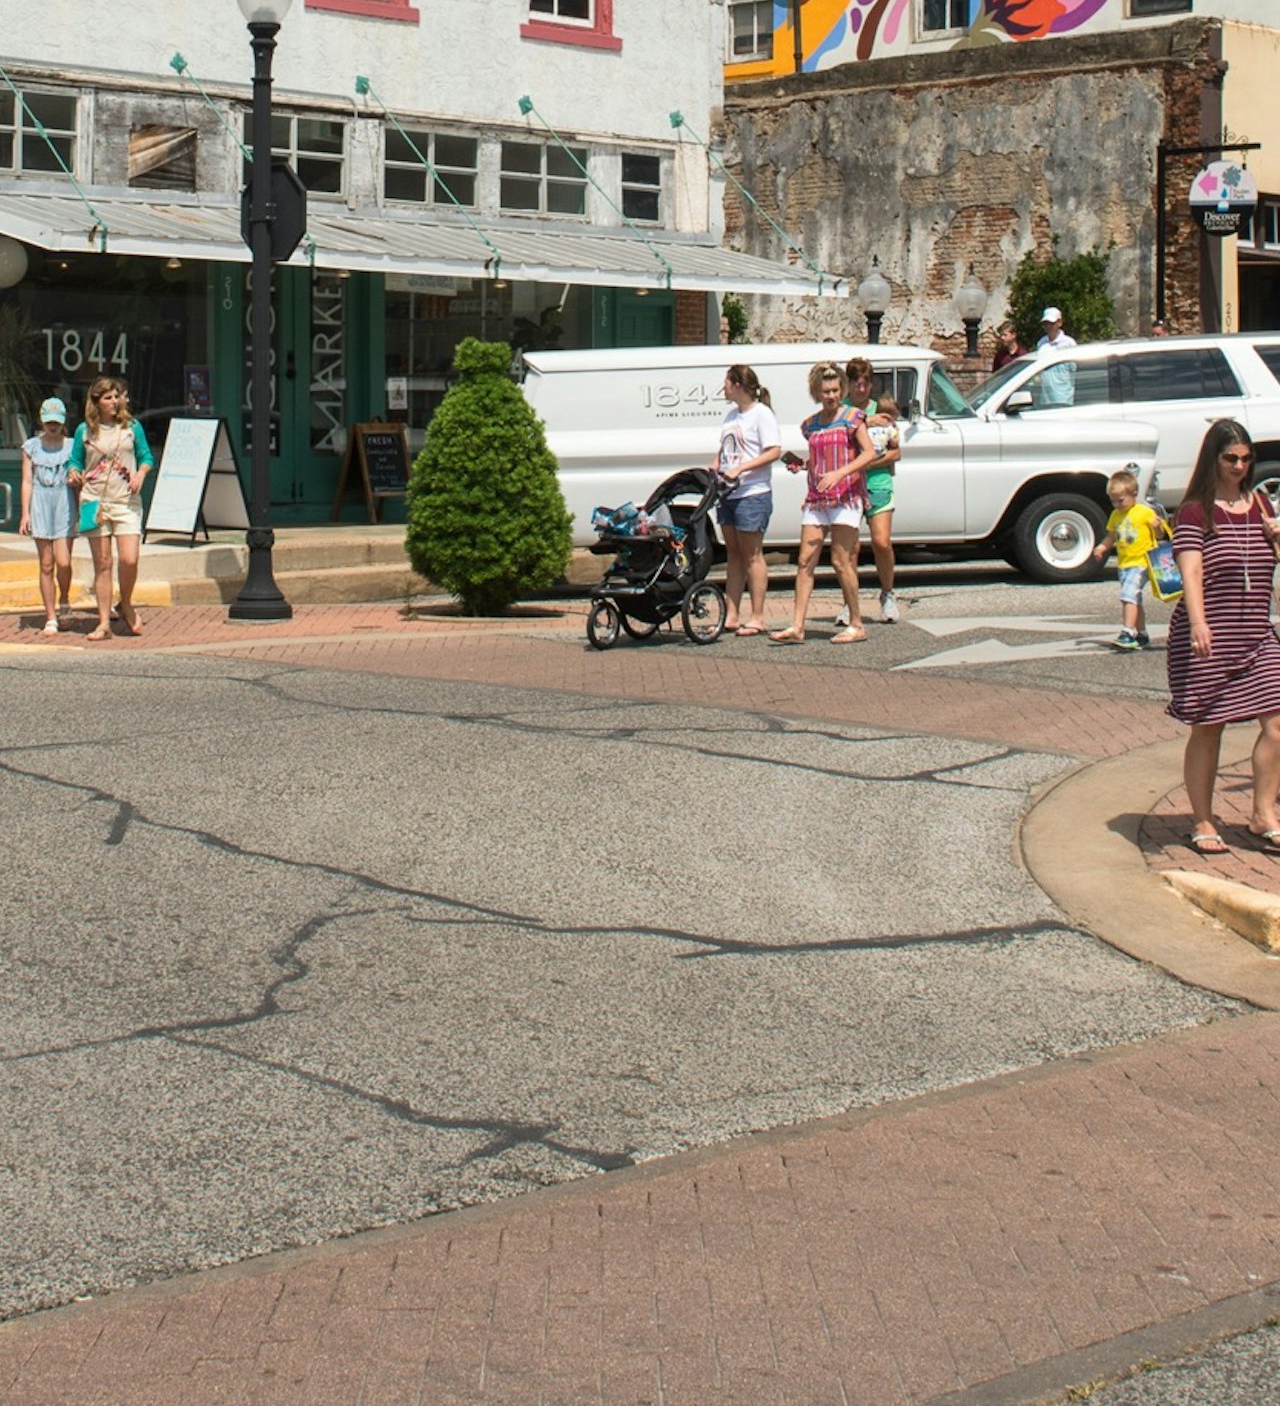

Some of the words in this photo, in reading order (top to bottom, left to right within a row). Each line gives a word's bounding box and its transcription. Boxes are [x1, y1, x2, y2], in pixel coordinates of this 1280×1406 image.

[1204, 210, 1241, 221] Discover
[42, 328, 129, 374] 1844
[312, 265, 344, 452] MARKET
